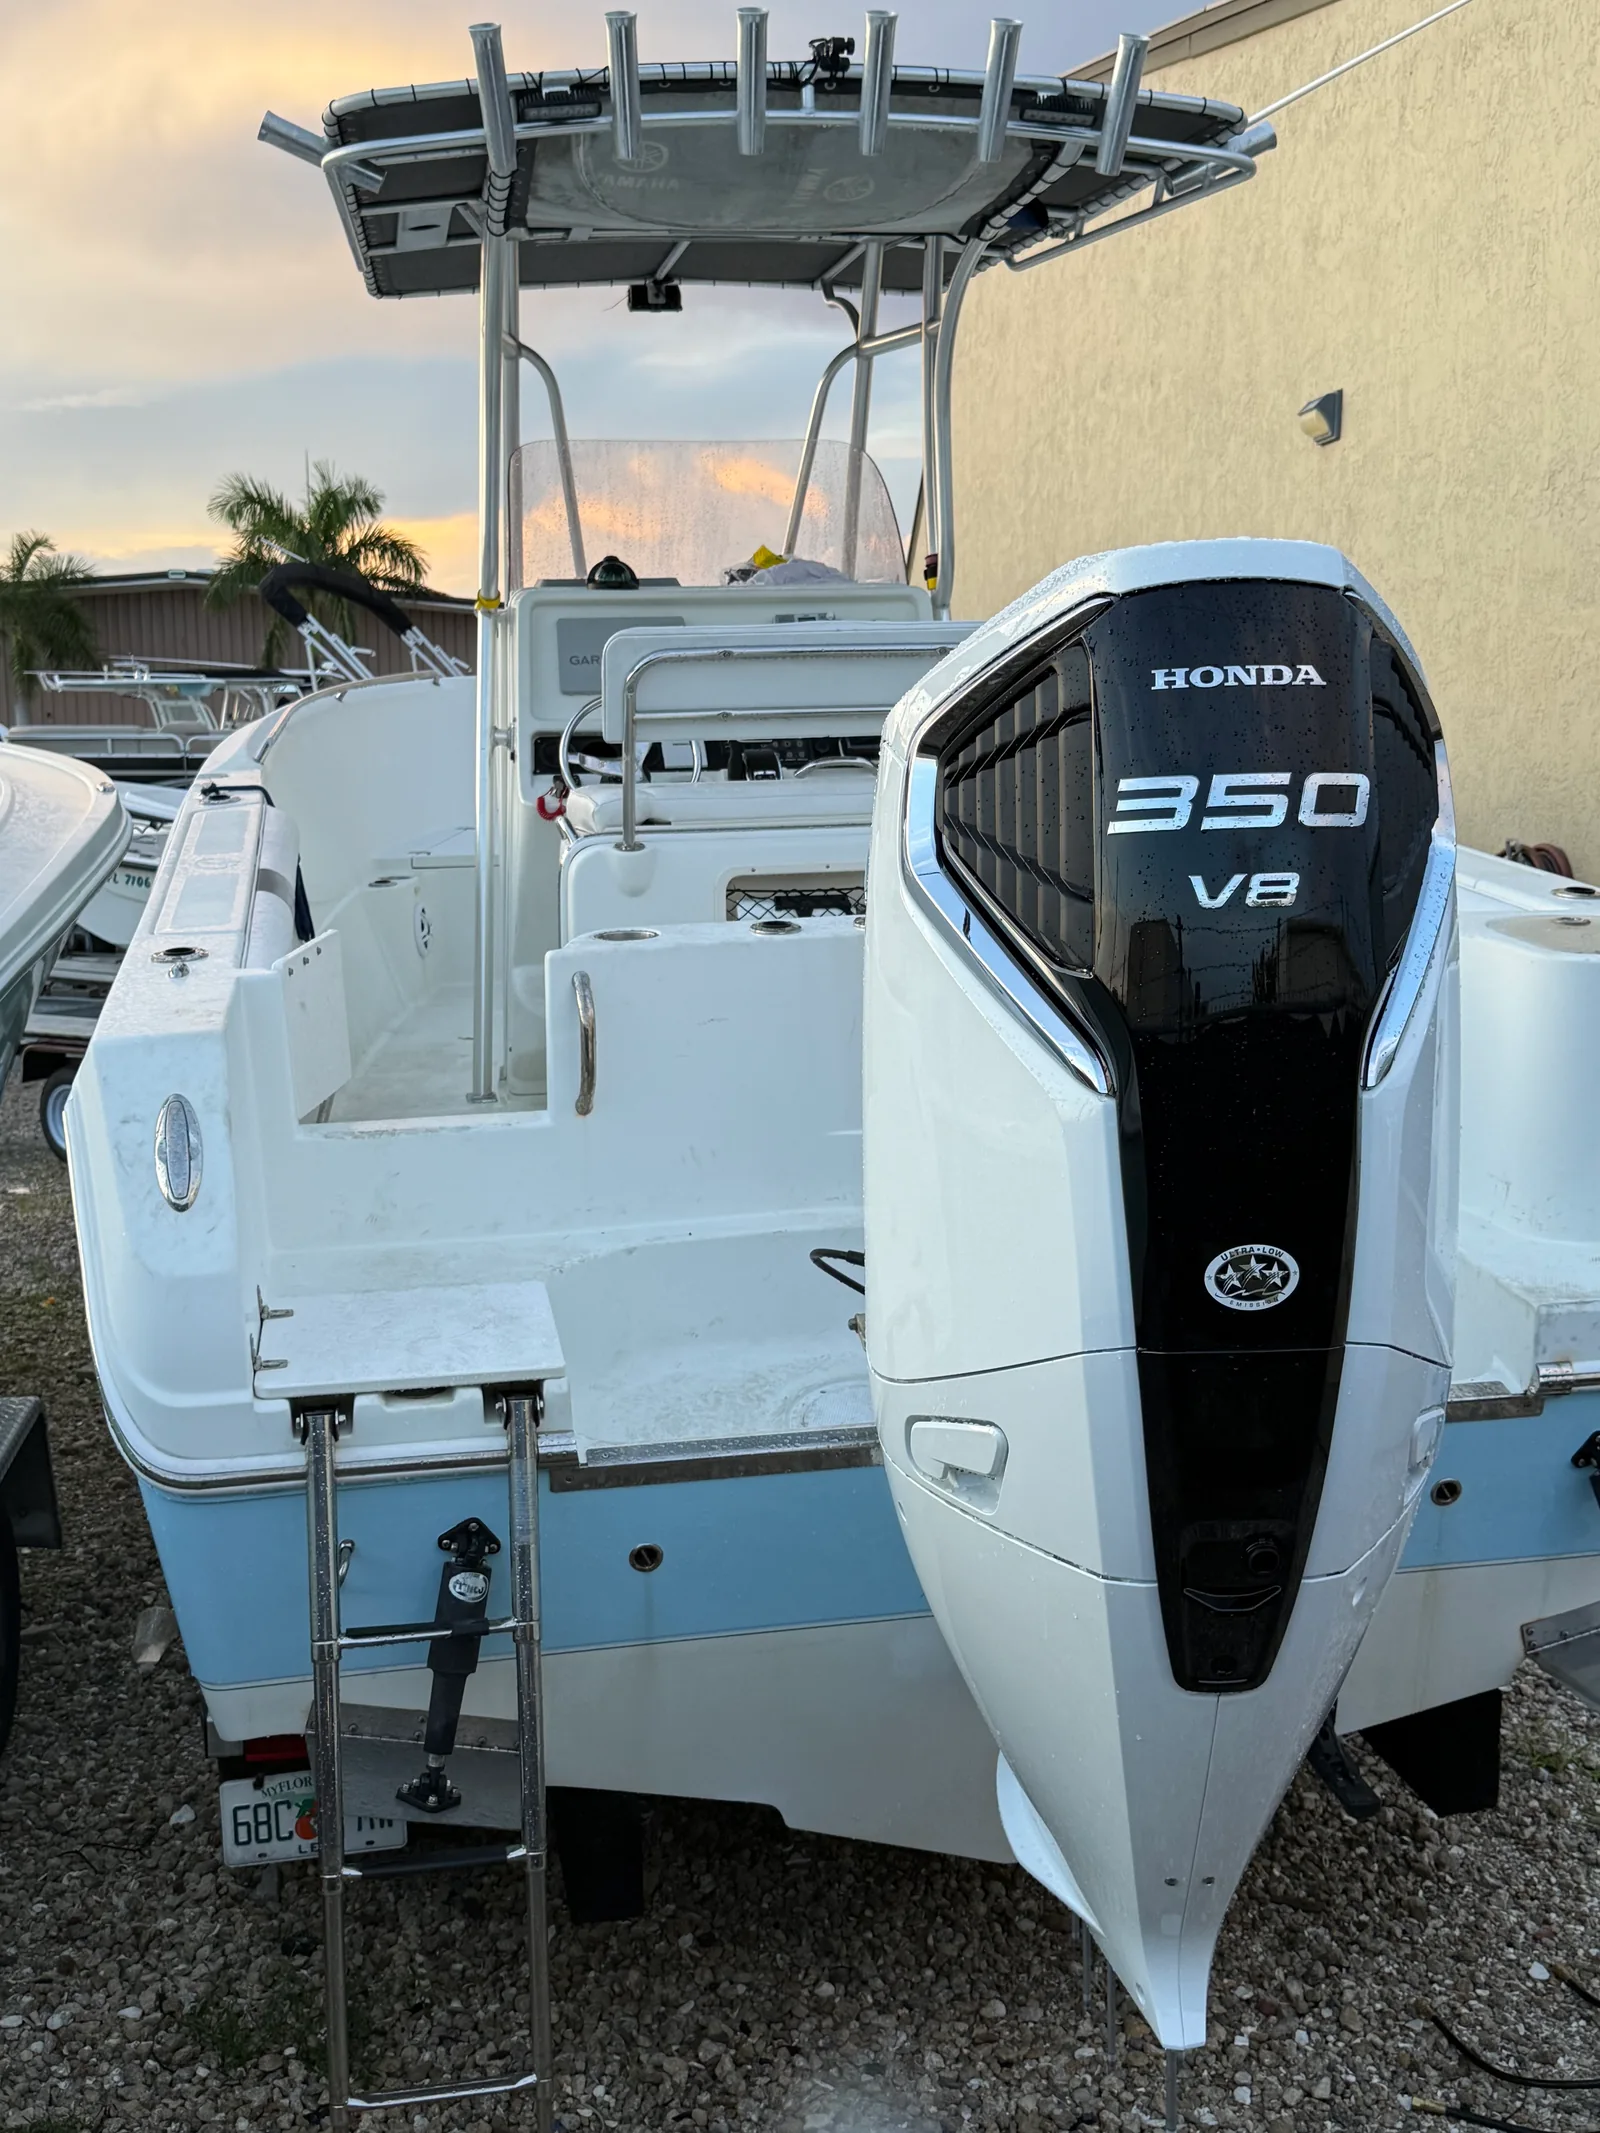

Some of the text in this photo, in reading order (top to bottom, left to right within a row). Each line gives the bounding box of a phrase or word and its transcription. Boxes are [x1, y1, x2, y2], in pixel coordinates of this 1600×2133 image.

[1151, 664, 1327, 691] HONDA
[1107, 772, 1370, 835] 350
[1188, 872, 1300, 909] V8
[1229, 1296, 1280, 1309] EMISSION
[232, 1799, 294, 1846] 68C
